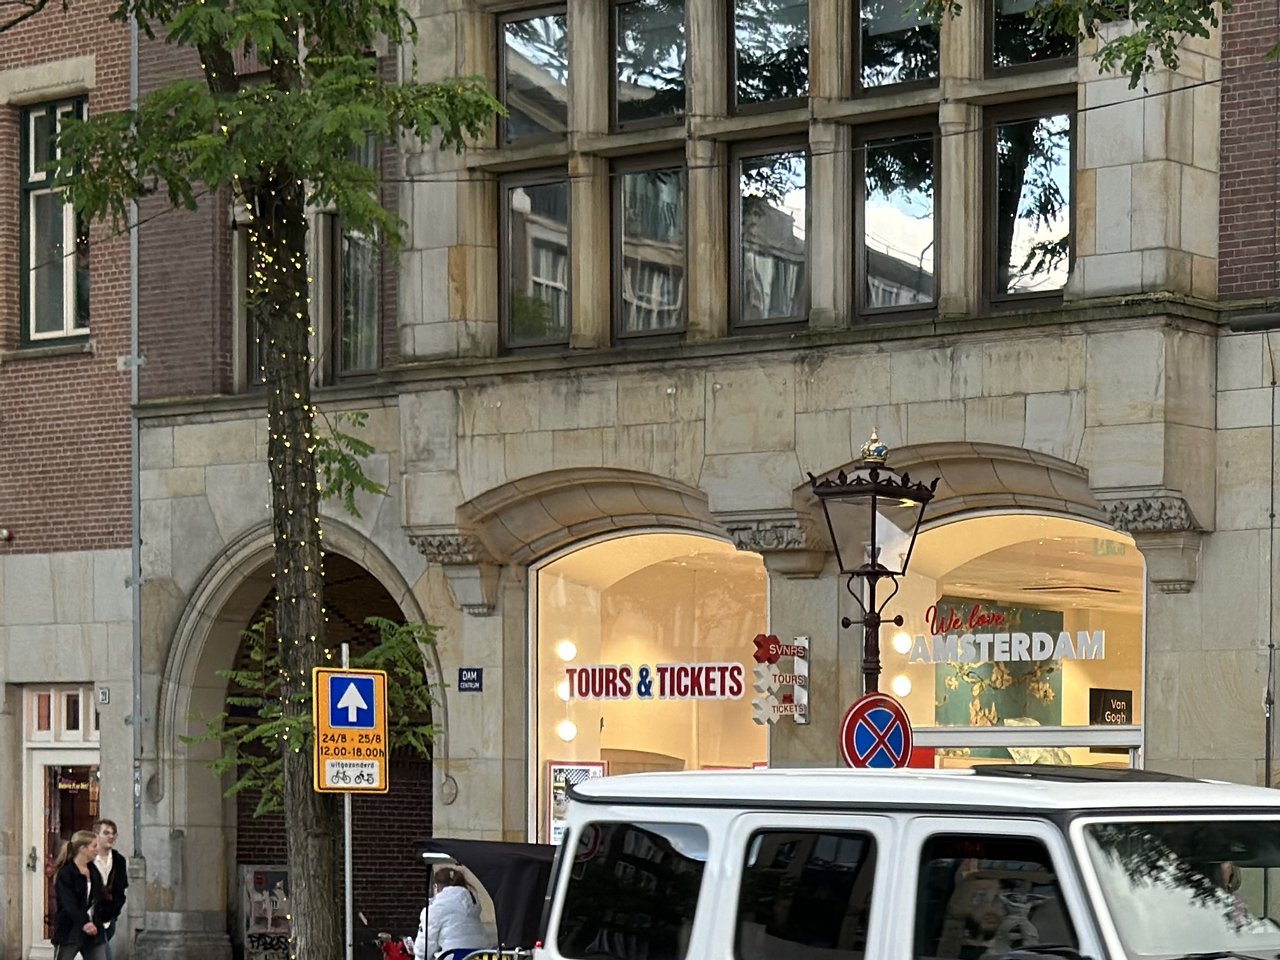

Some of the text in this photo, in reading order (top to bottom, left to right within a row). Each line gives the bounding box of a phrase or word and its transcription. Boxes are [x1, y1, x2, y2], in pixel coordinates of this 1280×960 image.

[925, 604, 1007, 636] We love
[769, 644, 805, 657] SVNRS
[908, 630, 1106, 664] AMSTERDAM
[462, 670, 478, 681] DAM
[566, 665, 744, 698] TOURS & TICKETS
[772, 673, 804, 685] TOURS
[771, 704, 804, 714] TICKETS
[1110, 698, 1127, 710] Van
[1104, 711, 1127, 724] Gogh
[322, 733, 347, 745] 24/8
[358, 734, 382, 745] 25/8
